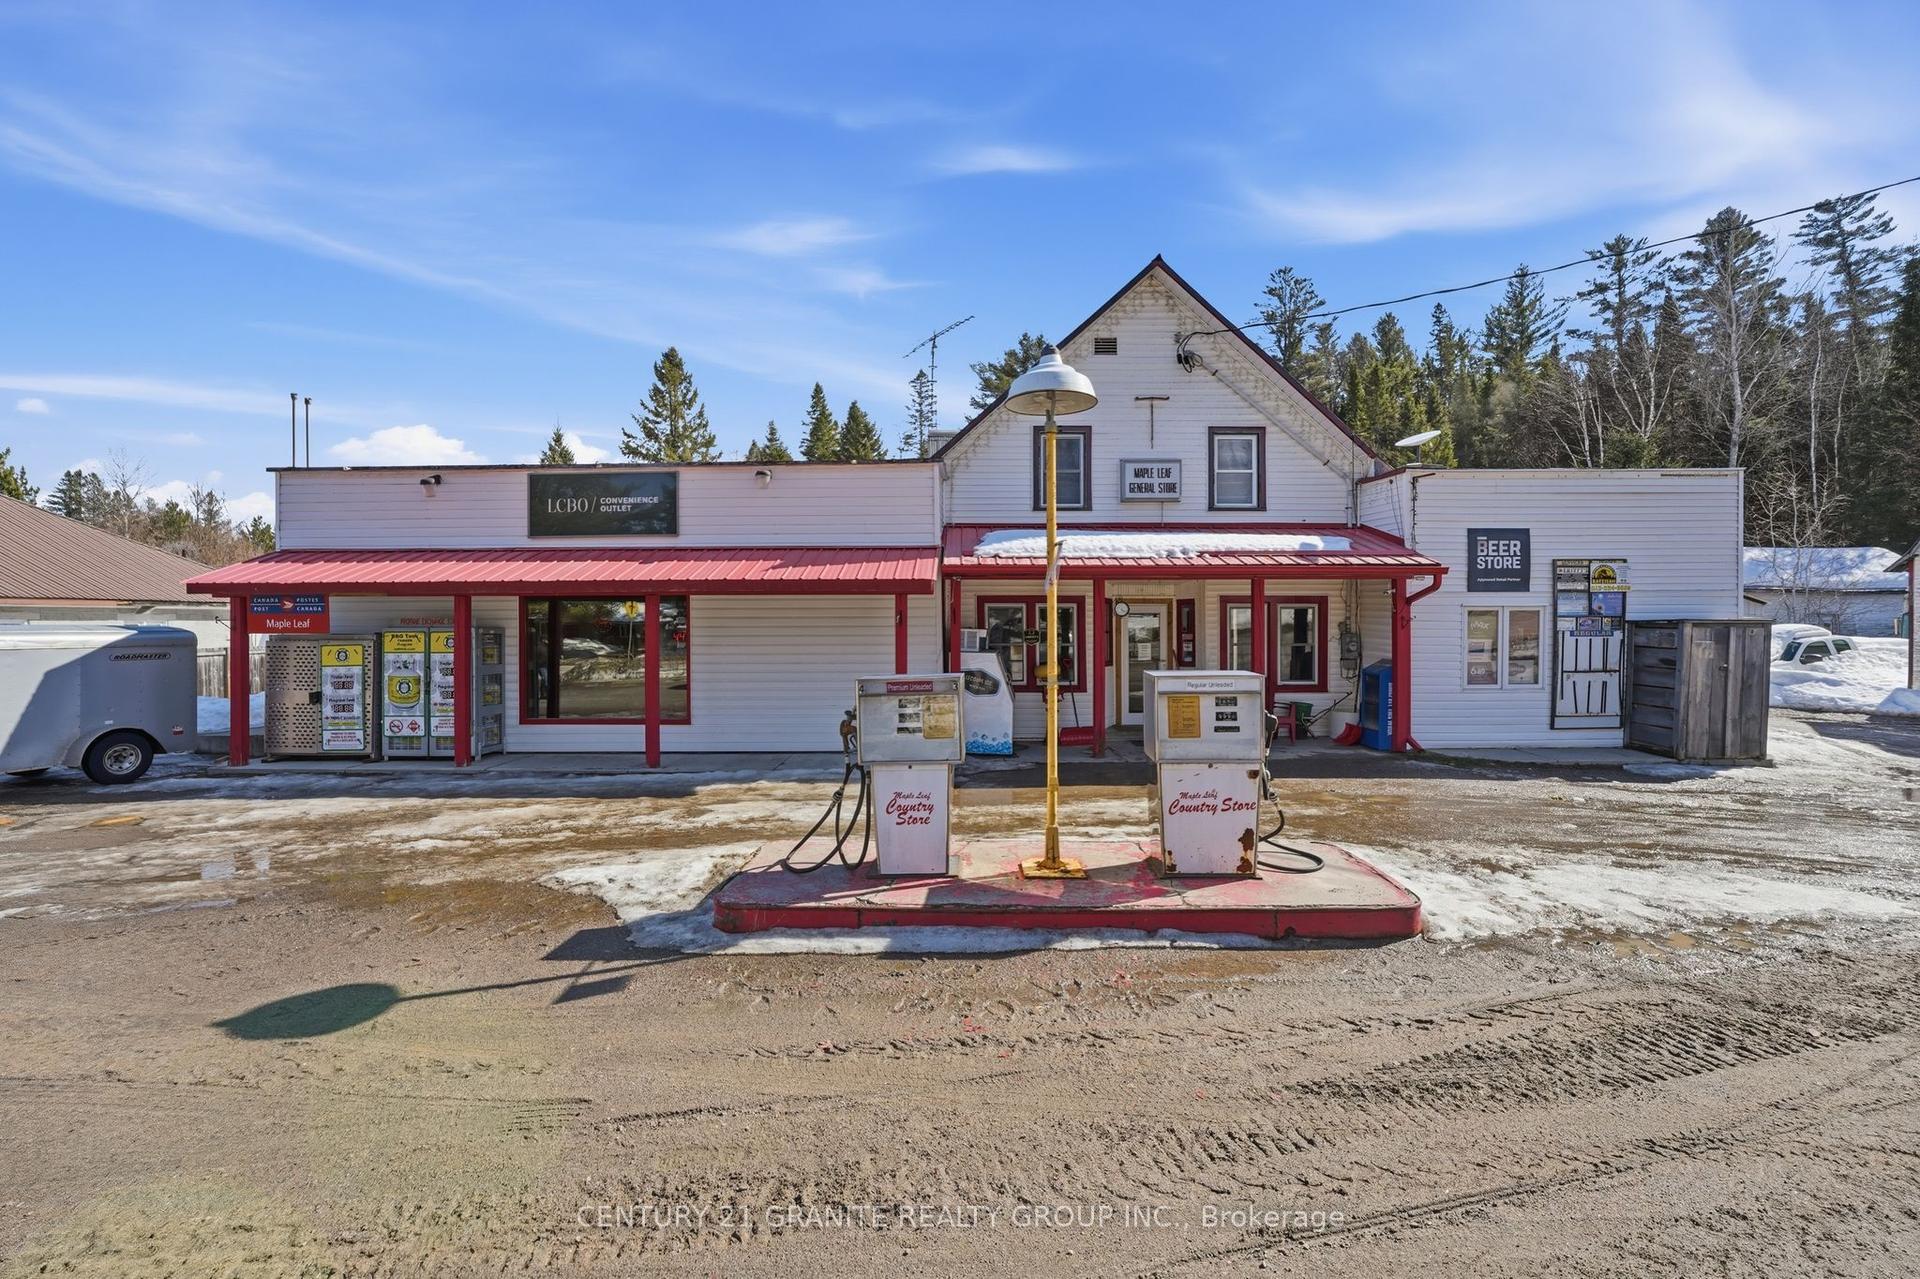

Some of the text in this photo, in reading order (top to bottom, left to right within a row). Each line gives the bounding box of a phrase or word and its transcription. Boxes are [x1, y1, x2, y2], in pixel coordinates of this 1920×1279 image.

[1134, 468, 1172, 478] MAPLE LEAF
[1129, 481, 1178, 494] GENERAL STORE
[547, 496, 660, 513] LCBO CONVENIENCE
[1477, 539, 1521, 556] BEER
[1477, 556, 1521, 569] STORE
[266, 618, 311, 630] Maple Leaf
[887, 684, 909, 692] Premium
[1187, 681, 1206, 689] Regular
[893, 791, 932, 800] Maple Leaf
[1179, 791, 1201, 800] Maple
[885, 798, 935, 815] Country
[1168, 797, 1257, 816] Country Store
[895, 810, 931, 826] Store
